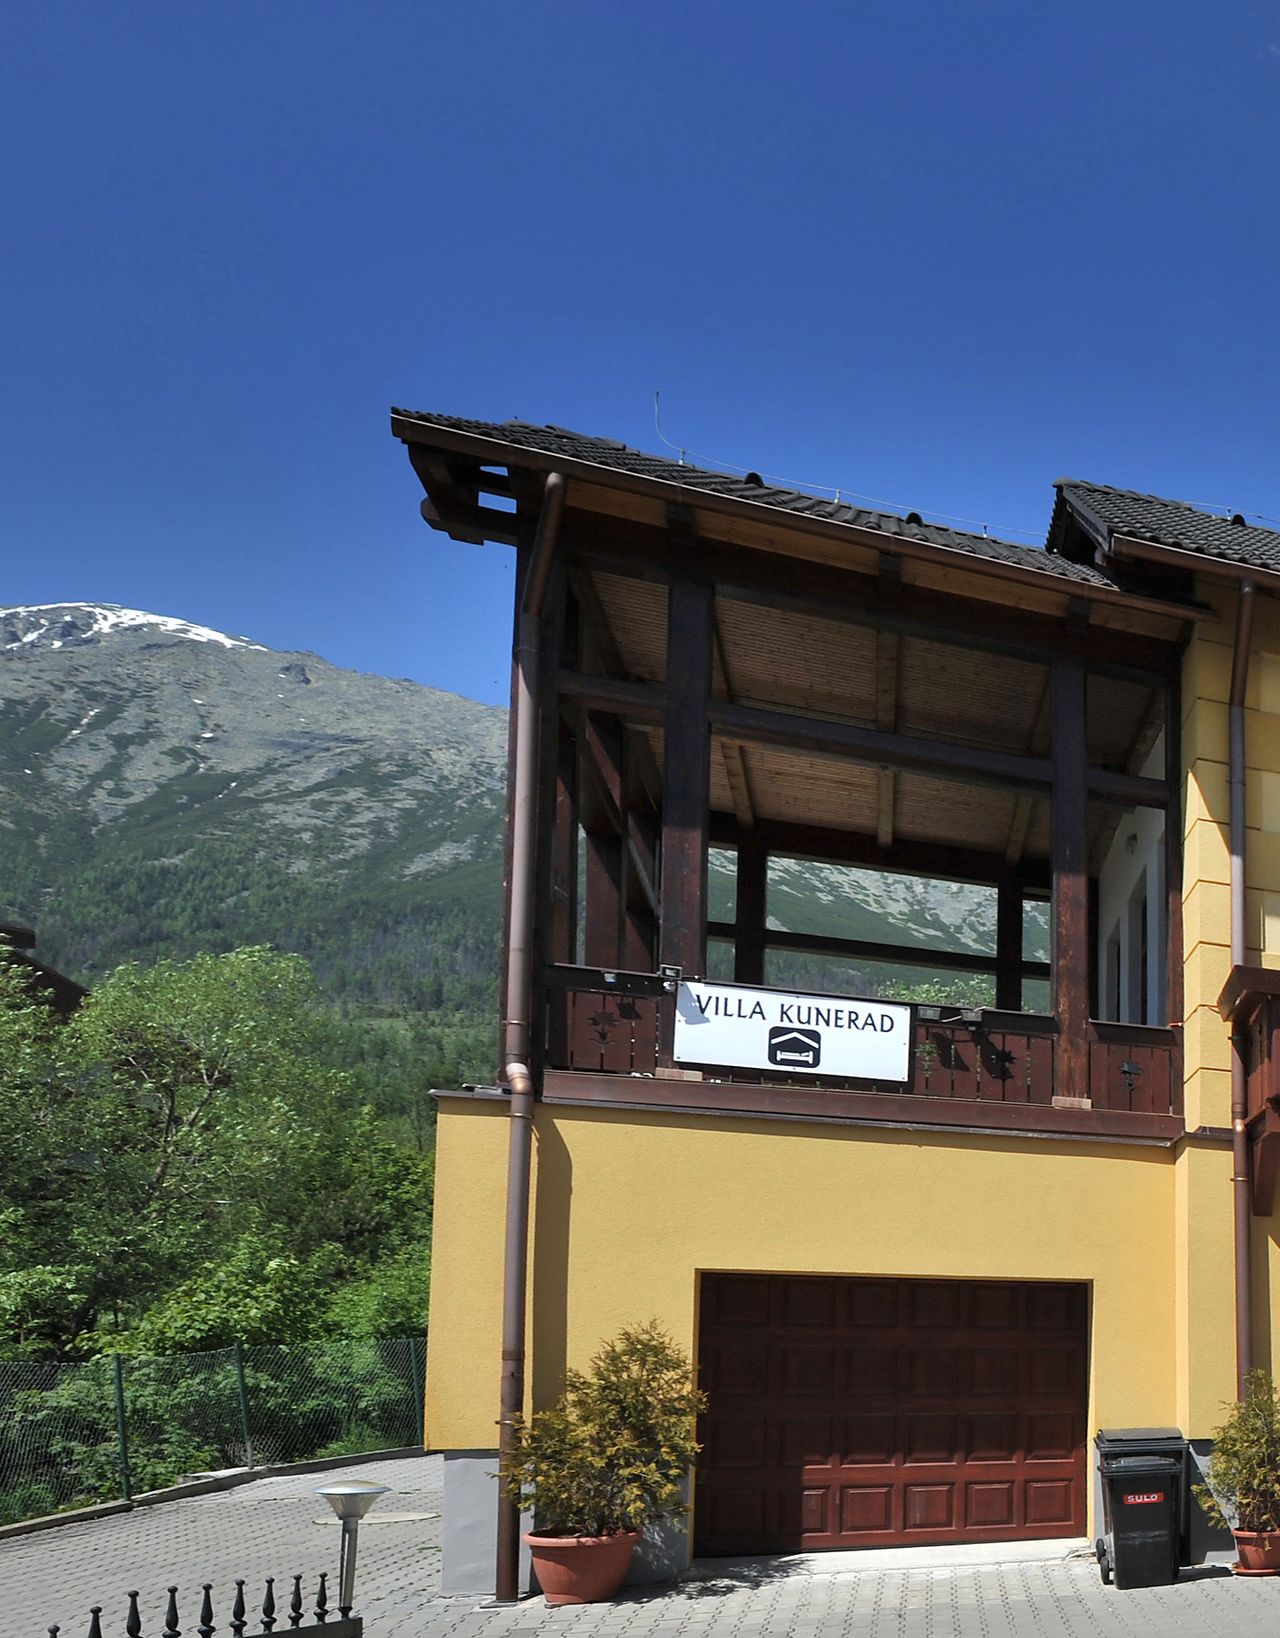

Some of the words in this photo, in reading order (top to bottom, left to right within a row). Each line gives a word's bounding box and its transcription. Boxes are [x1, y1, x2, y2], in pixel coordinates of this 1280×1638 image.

[696, 994, 766, 1021] VILLA
[780, 1003, 895, 1033] KUNERAD
[1127, 1494, 1158, 1502] SULO
